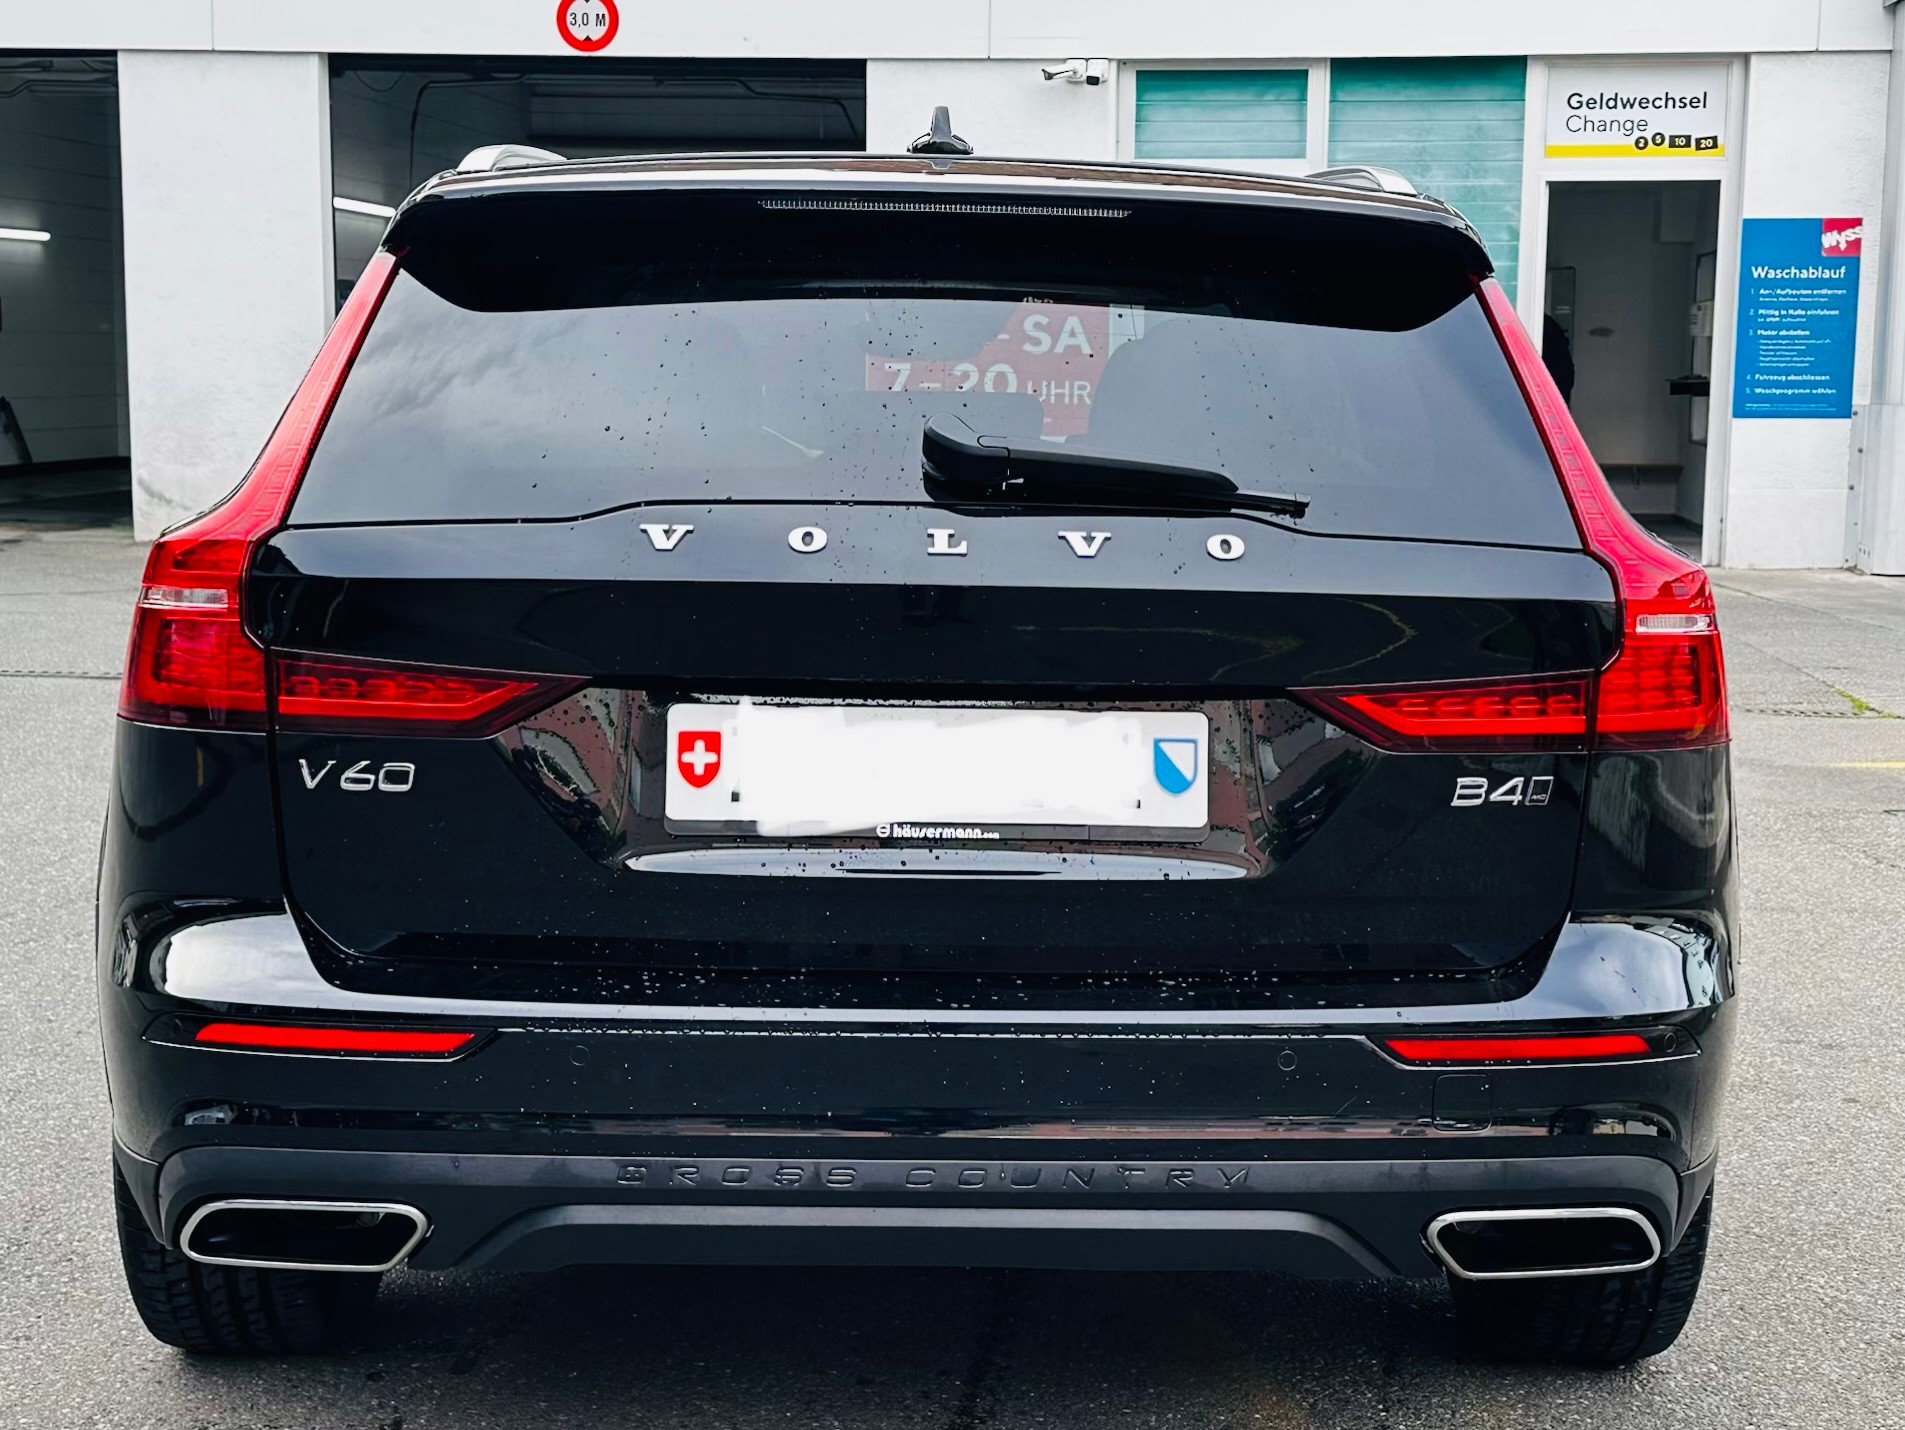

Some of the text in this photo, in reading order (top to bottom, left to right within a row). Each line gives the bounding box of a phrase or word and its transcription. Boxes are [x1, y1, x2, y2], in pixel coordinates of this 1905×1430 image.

[569, 12, 606, 28] 3,0 M
[1567, 91, 1708, 110] Geldwechsel
[1566, 114, 1649, 137] Change
[1700, 138, 1713, 148] 20
[1751, 265, 1846, 279] Waschablauf
[1022, 314, 1092, 355] SA
[884, 363, 911, 392] 7
[952, 363, 1017, 393] 20
[1026, 380, 1091, 404] UHR
[639, 523, 1247, 561] VOLVO
[299, 759, 416, 792] V60
[1451, 777, 1525, 807] B4
[617, 1166, 1252, 1190] CROSS COUNTRY
